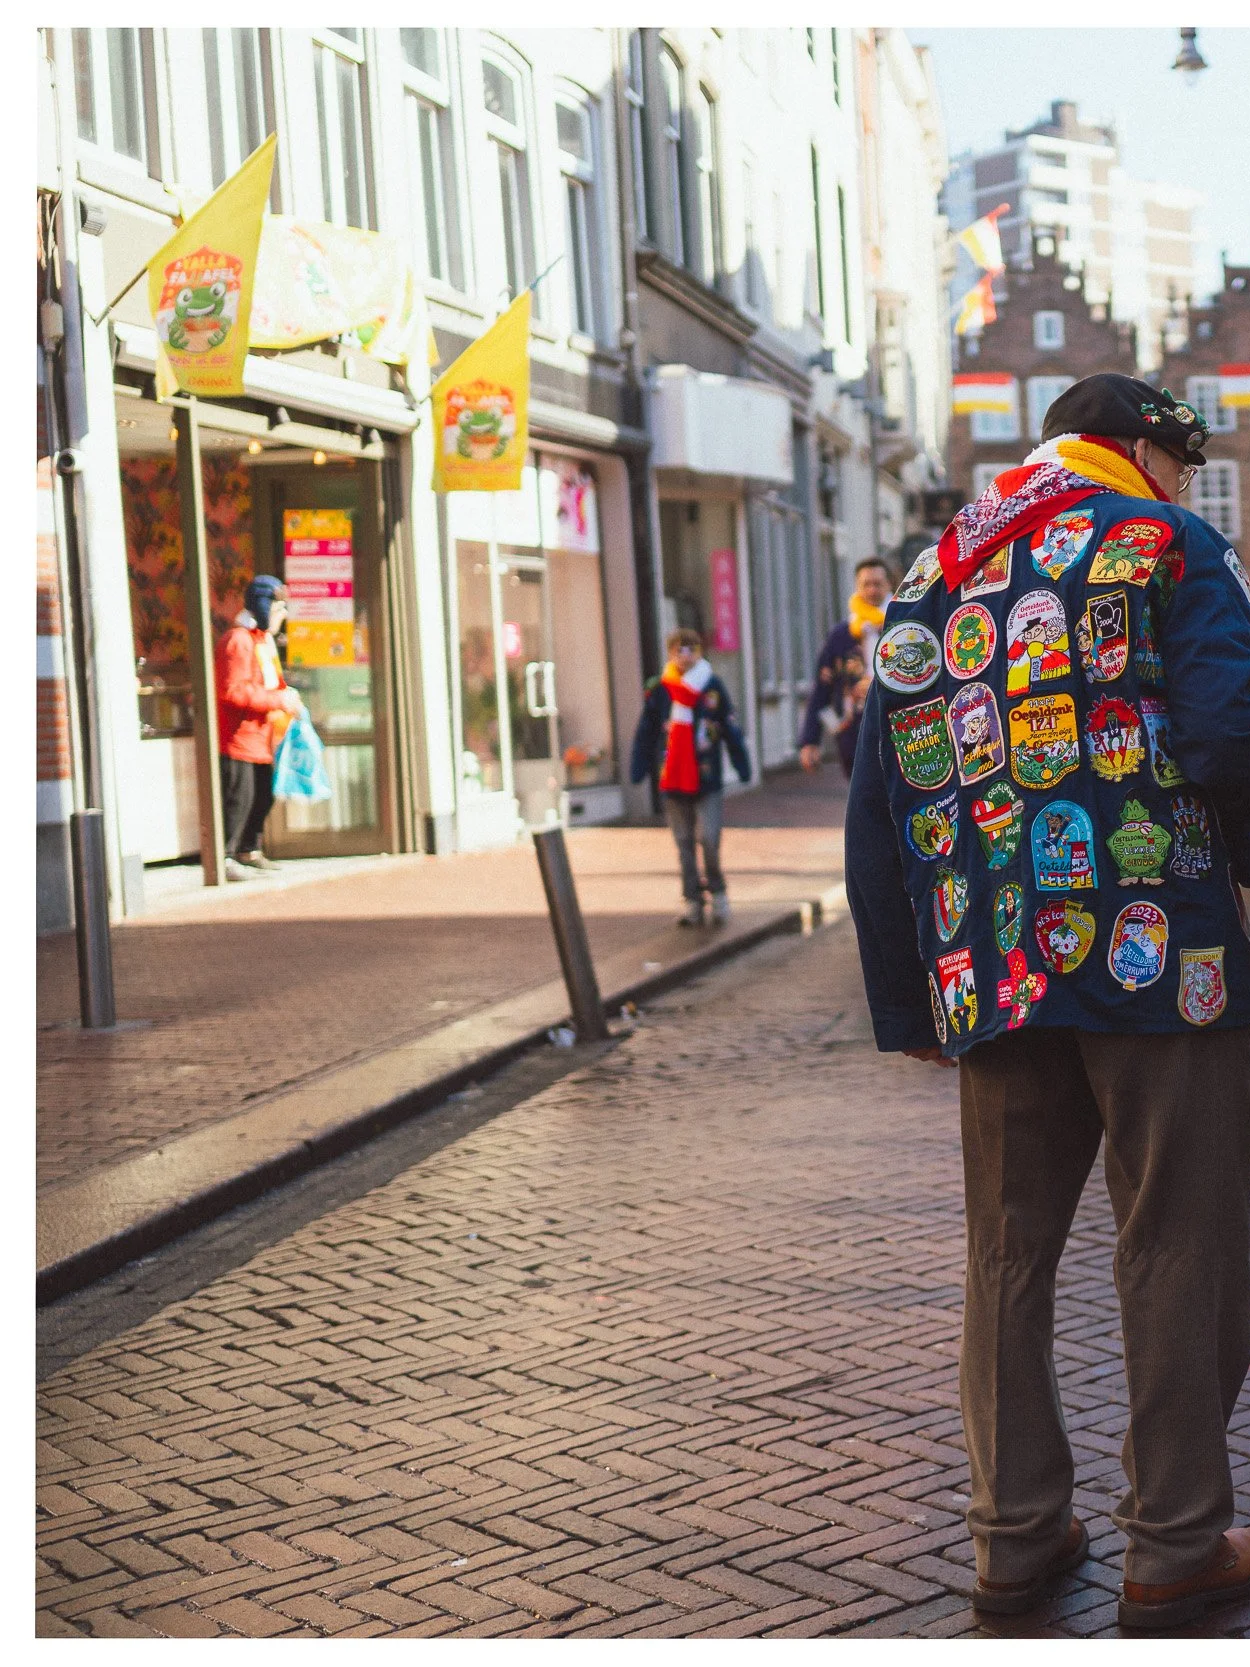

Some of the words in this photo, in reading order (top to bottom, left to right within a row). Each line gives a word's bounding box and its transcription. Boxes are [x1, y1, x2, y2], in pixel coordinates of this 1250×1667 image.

[1032, 661, 1040, 678] 2003
[1011, 704, 1074, 722] Oeteldonk
[920, 760, 940, 774] 2007
[1130, 906, 1158, 922] 2023
[938, 950, 970, 968] OETELDONK
[1123, 944, 1157, 964] OETELDONK
